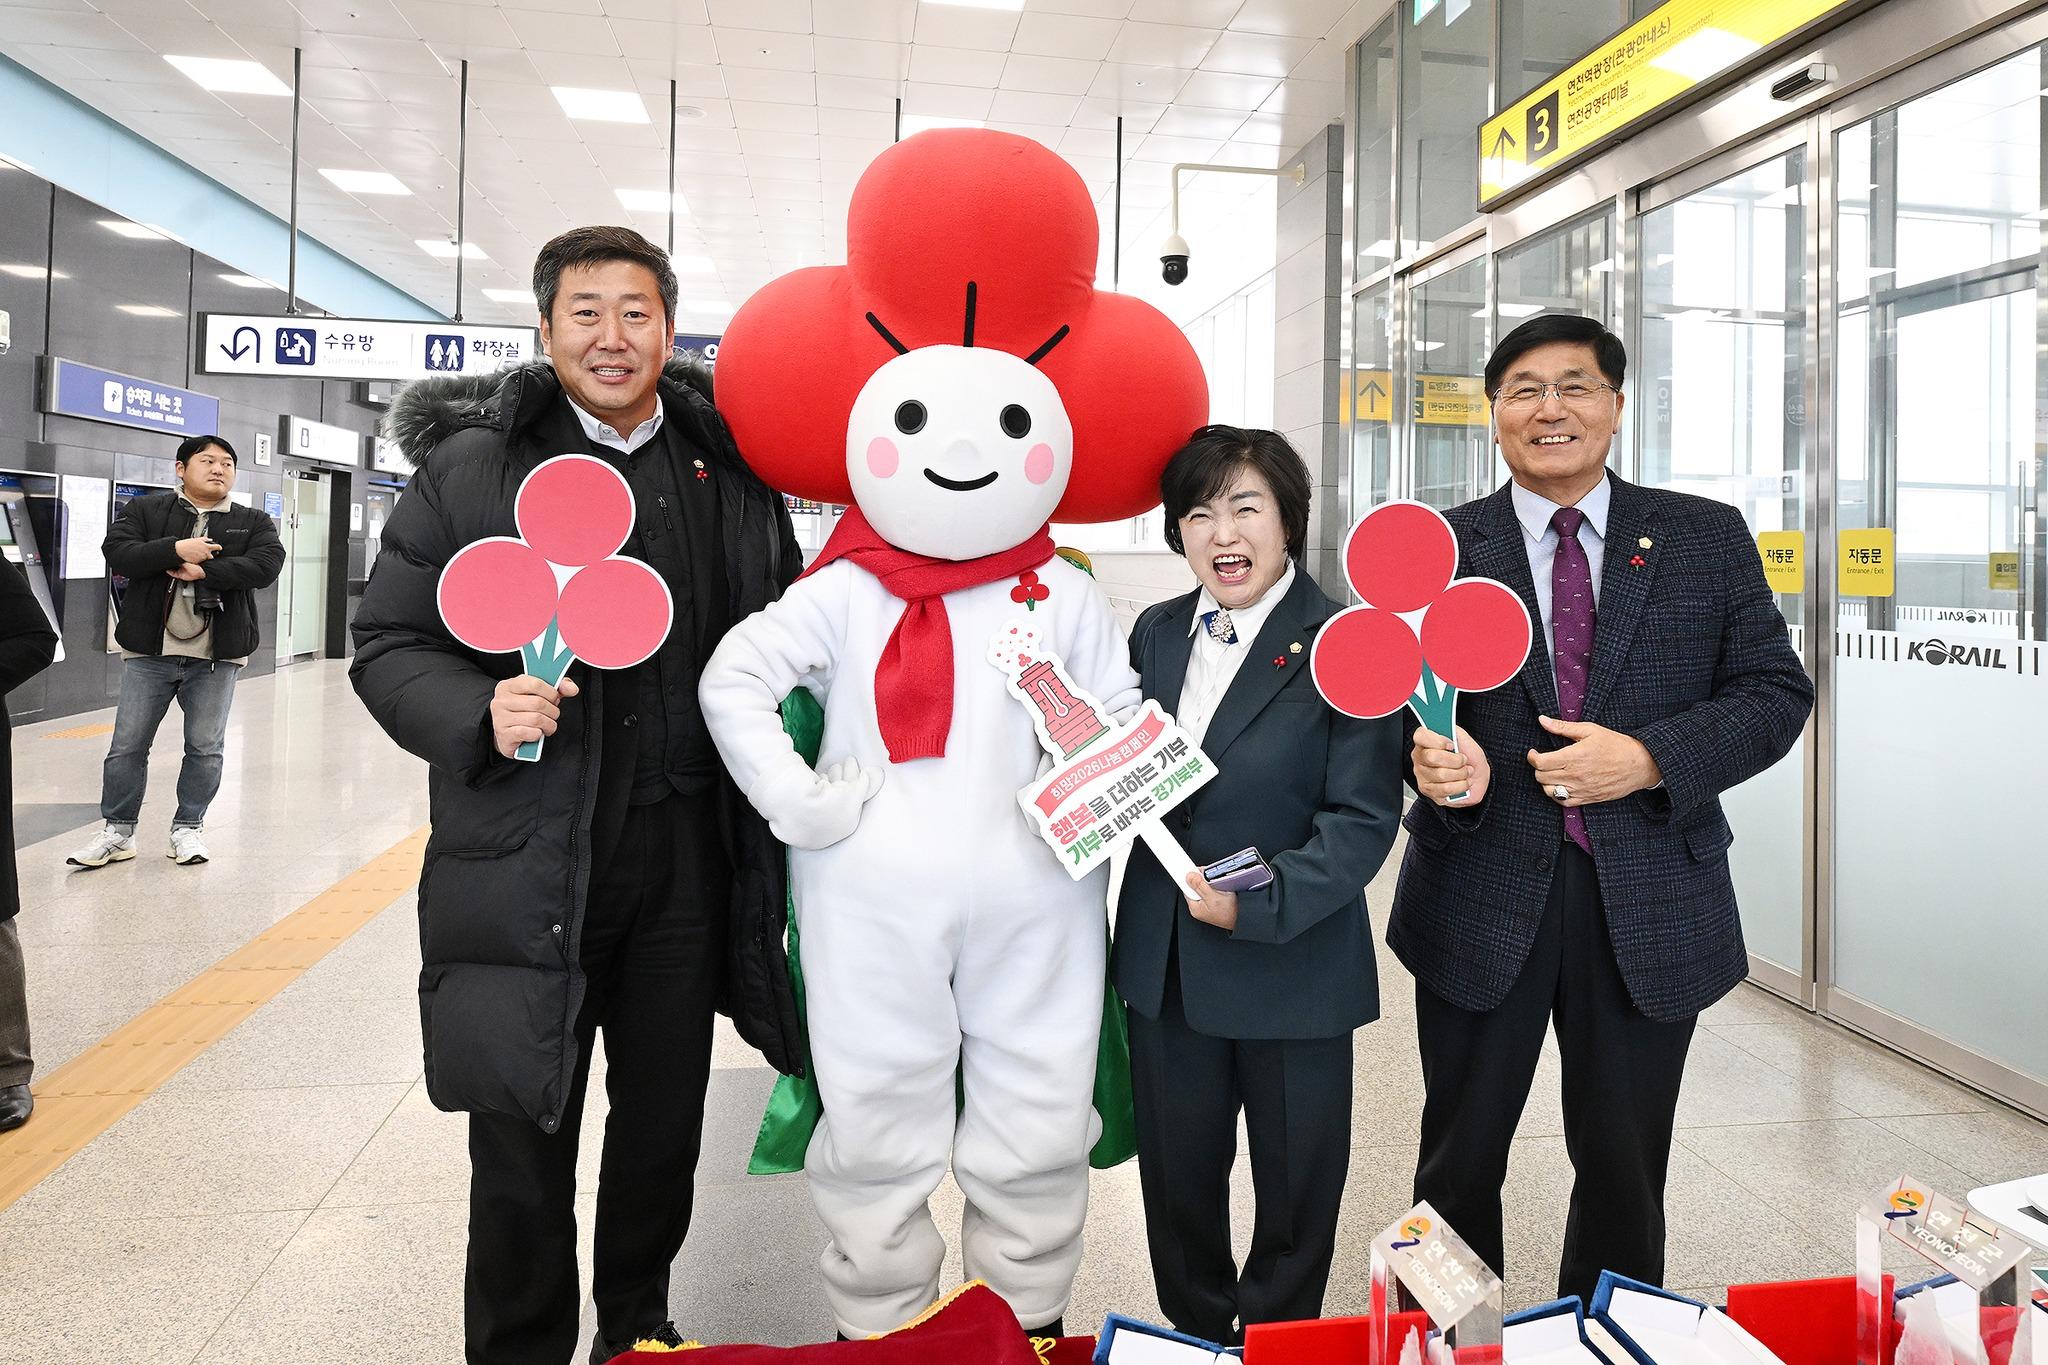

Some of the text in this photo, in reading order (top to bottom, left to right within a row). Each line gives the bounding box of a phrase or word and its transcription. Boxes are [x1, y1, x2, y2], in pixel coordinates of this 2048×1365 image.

[1567, 16, 1671, 97] 연천역광장(관광안내소)
[1567, 80, 1629, 130] 연천공영터미널
[1532, 107, 1551, 153] 3
[324, 333, 374, 352] 수유방
[472, 340, 519, 358] 화장실
[126, 386, 182, 414] 승차권 사는 곳
[1766, 549, 1794, 564] 자동문
[1846, 566, 1870, 574] Entrance
[1848, 549, 1882, 564] 자동문
[1908, 638, 2006, 669] KORAIL
[1050, 730, 1153, 800] 희망2026나눔캠페인
[1050, 736, 1189, 846] 행복을 더하는 기부
[1066, 756, 1203, 866] 기부로 바꾸는 경기북부
[1912, 1225, 1986, 1277] YEONCHEON
[1408, 1256, 1458, 1313] YEONCHEON
